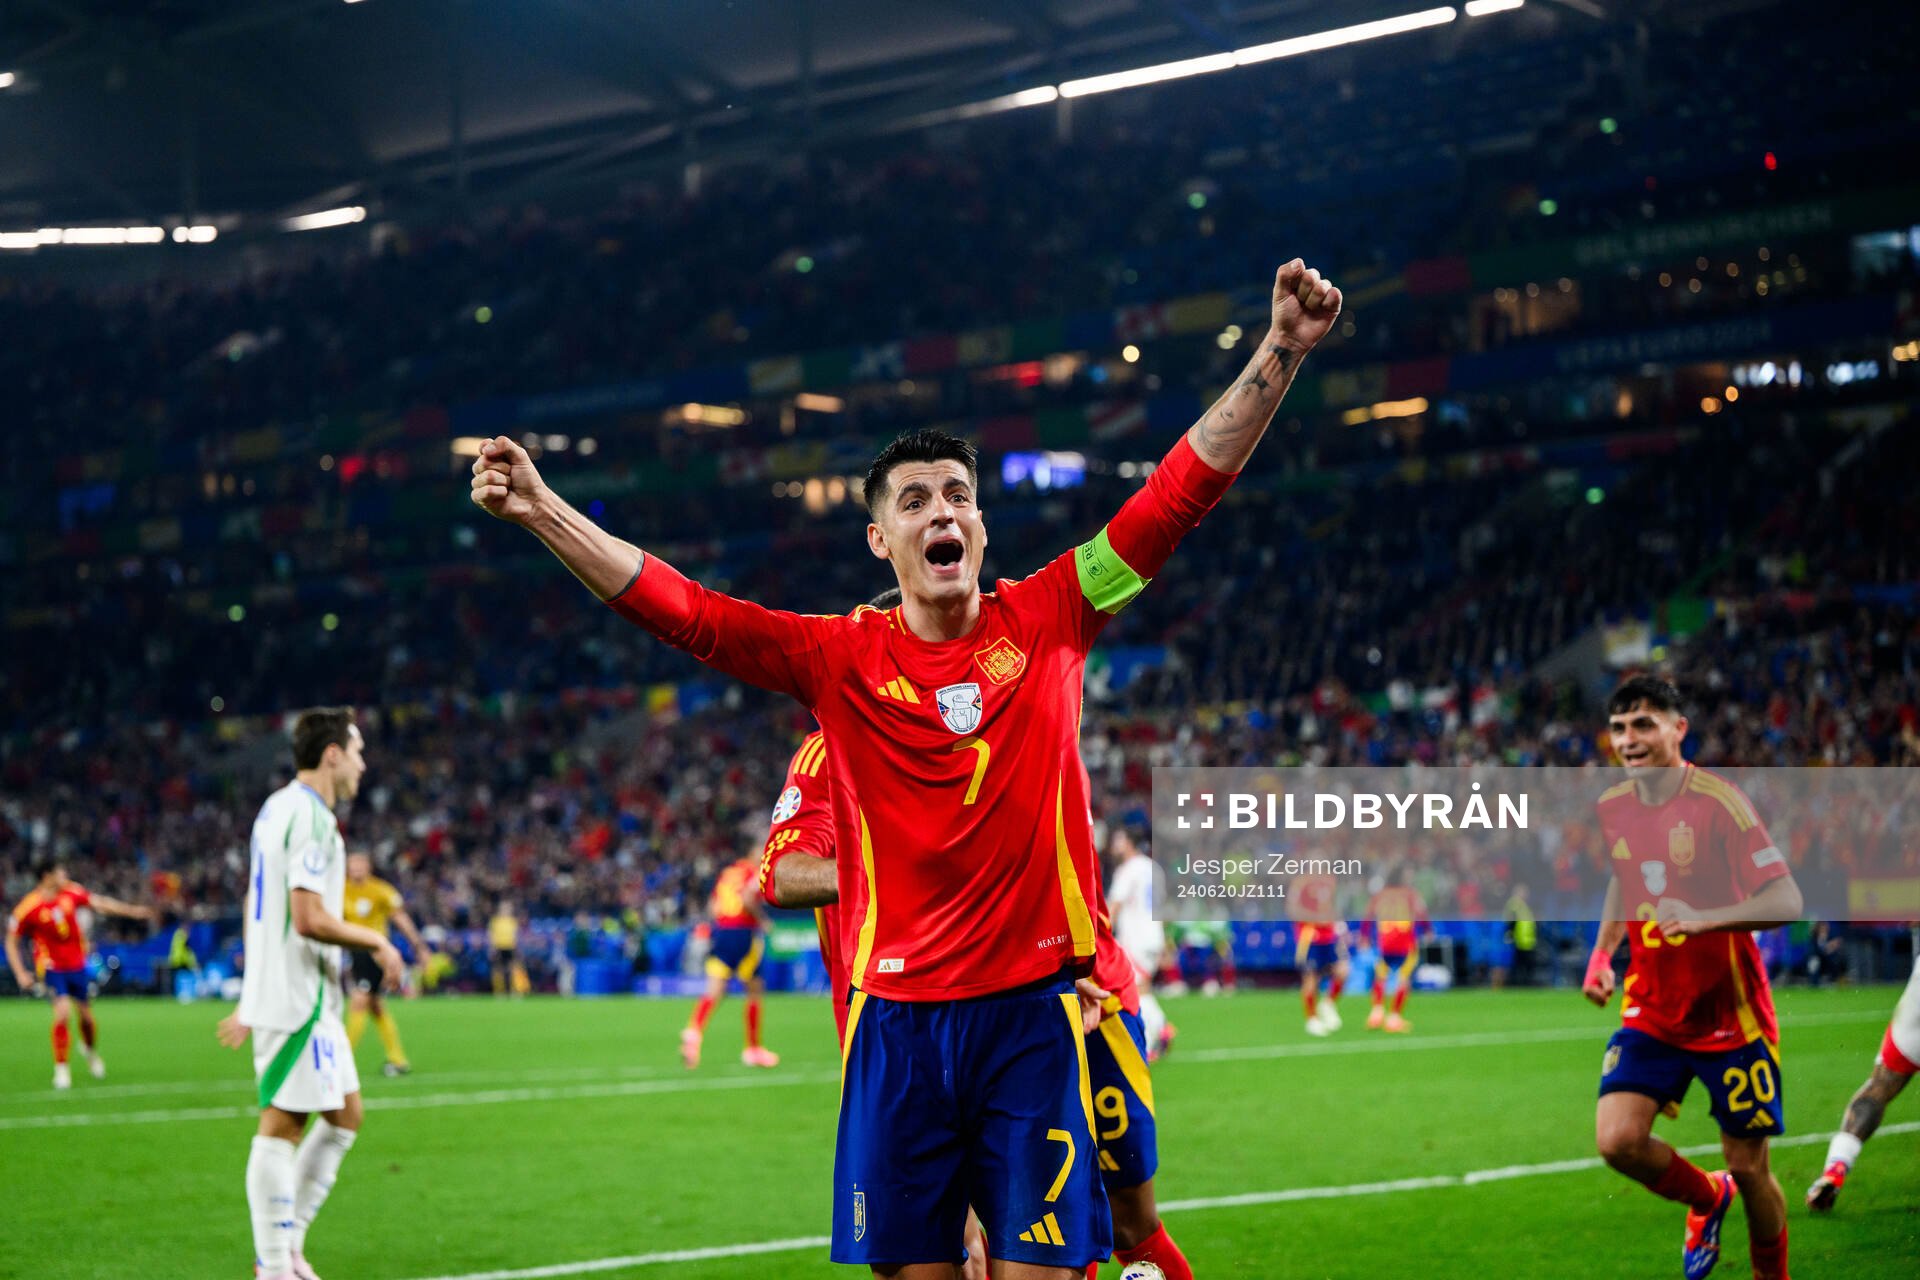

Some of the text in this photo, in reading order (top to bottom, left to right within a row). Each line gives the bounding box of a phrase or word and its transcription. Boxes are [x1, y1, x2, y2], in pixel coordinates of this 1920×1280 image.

[952, 736, 991, 806] 7
[312, 1035, 337, 1071] 14
[1722, 1058, 1776, 1113] 20
[1044, 1128, 1076, 1202] 7
